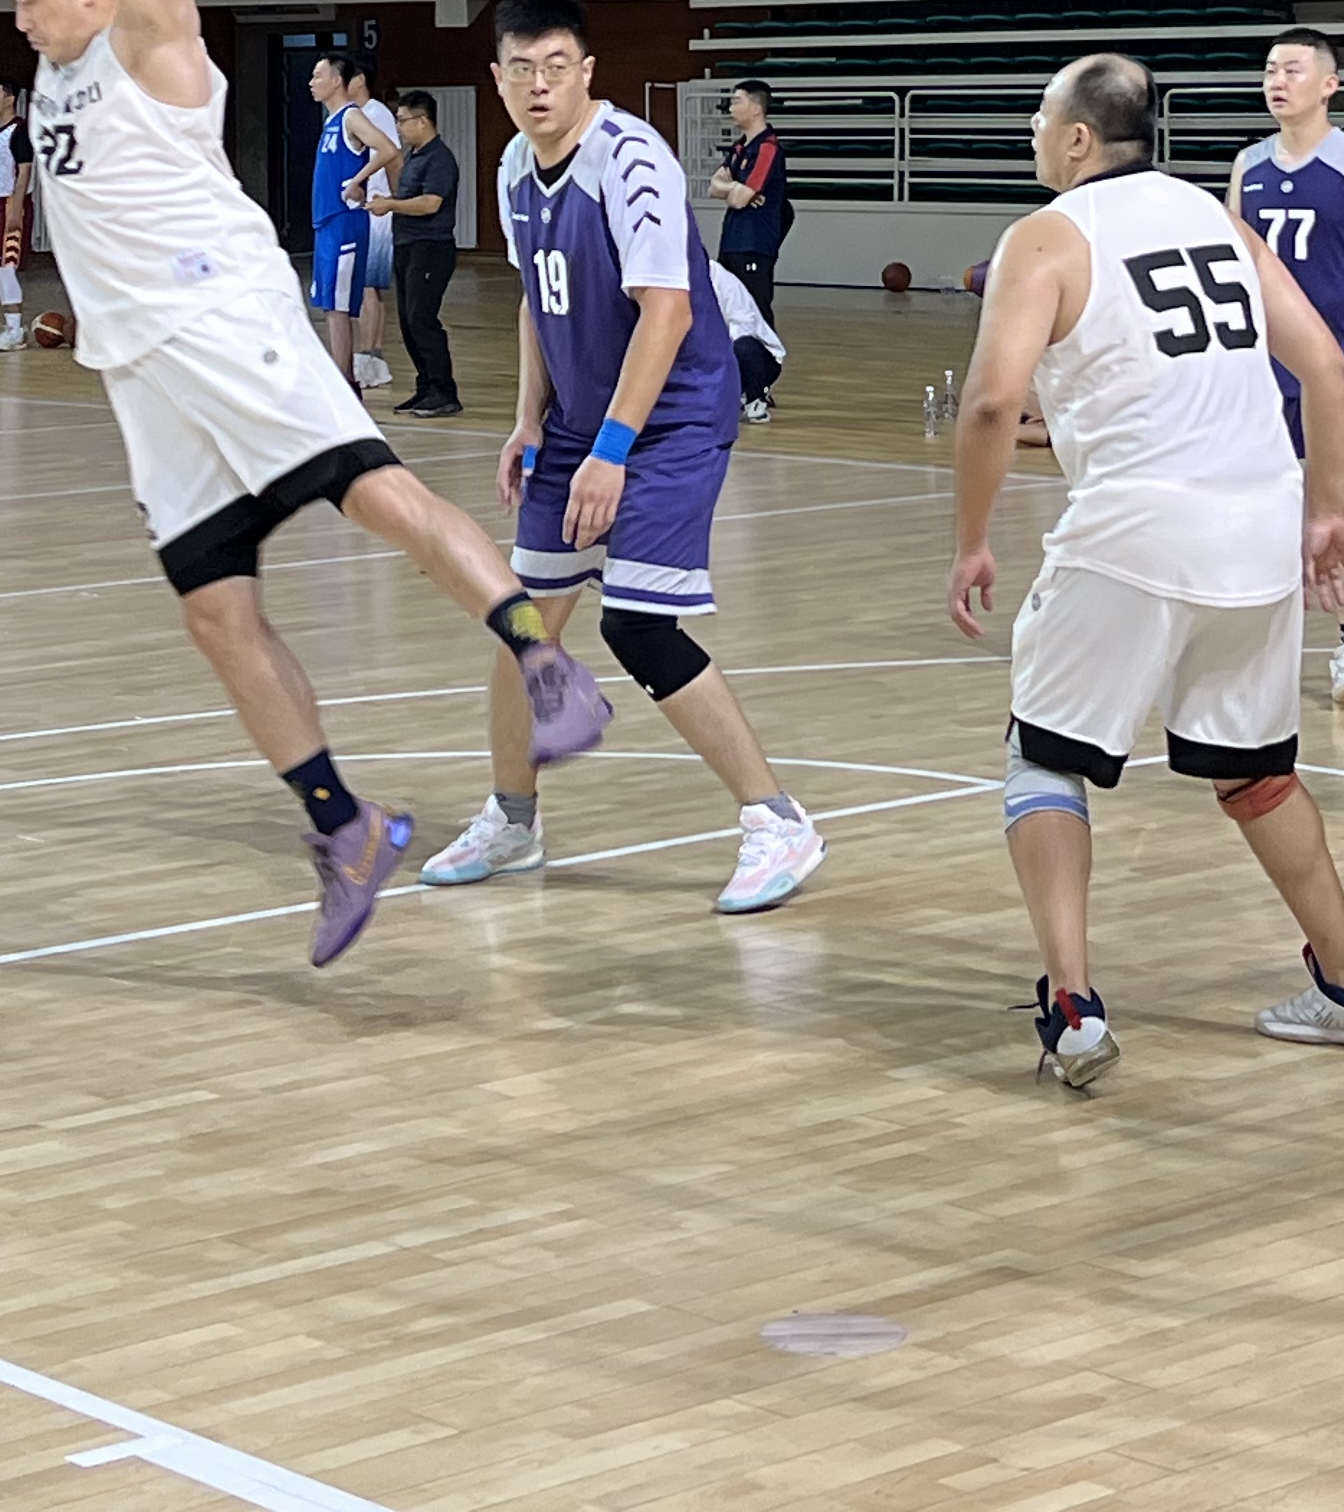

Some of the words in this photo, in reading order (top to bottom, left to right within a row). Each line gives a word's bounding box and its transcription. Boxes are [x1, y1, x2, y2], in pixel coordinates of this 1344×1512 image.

[363, 19, 377, 49] 5
[1258, 209, 1316, 261] 77
[533, 249, 569, 315] 19
[1122, 244, 1258, 358] 55
